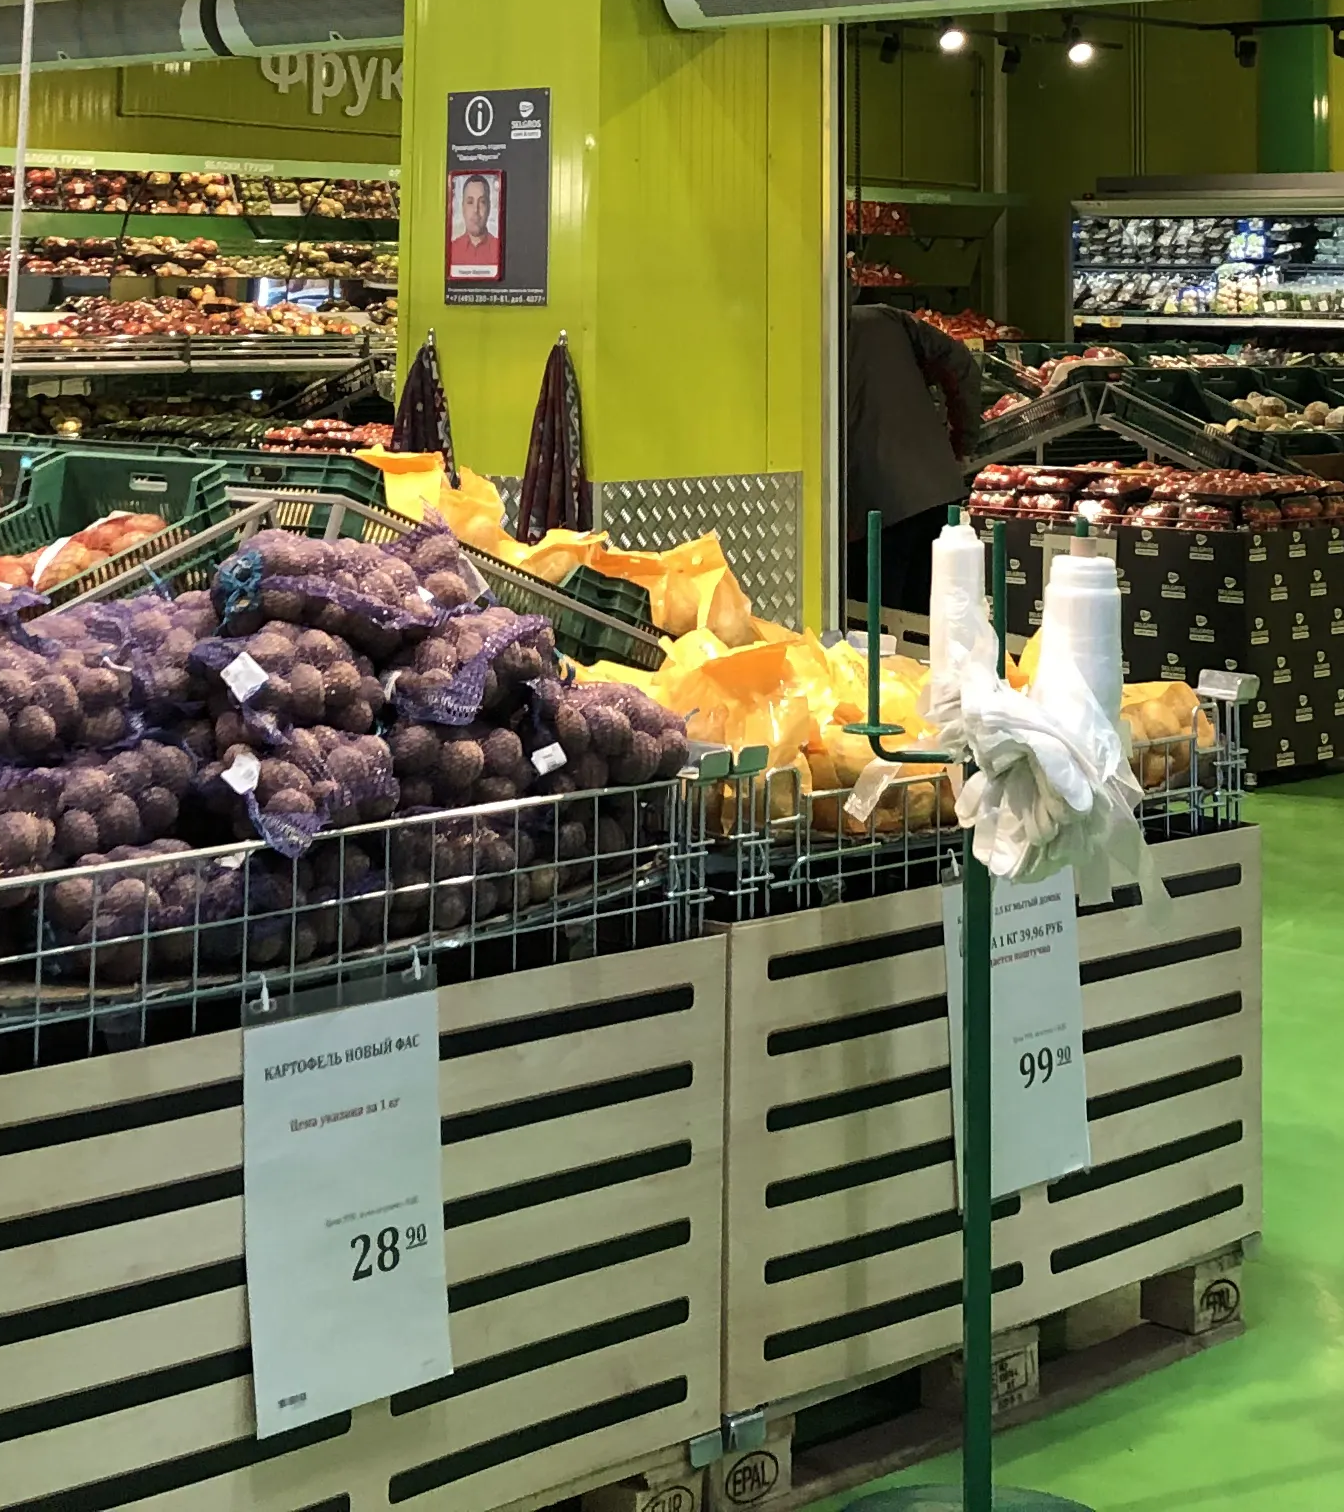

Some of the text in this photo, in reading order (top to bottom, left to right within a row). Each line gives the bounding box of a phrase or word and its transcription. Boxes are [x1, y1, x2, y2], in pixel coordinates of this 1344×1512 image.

[999, 935, 1004, 947] 1
[1007, 930, 1018, 945] КГ
[1019, 925, 1044, 943] 39,96
[1045, 921, 1063, 936] РУБ
[264, 1033, 421, 1082] КАРТОФЕЛЬ НОВЫЙ ФАС
[1019, 1045, 1072, 1088] 99 90
[289, 1117, 317, 1132] Цена
[319, 1106, 364, 1128] указана
[366, 1102, 378, 1114] за
[387, 1096, 401, 1109] кг
[350, 1223, 428, 1281] 28 90
[732, 1461, 770, 1497] EPAL
